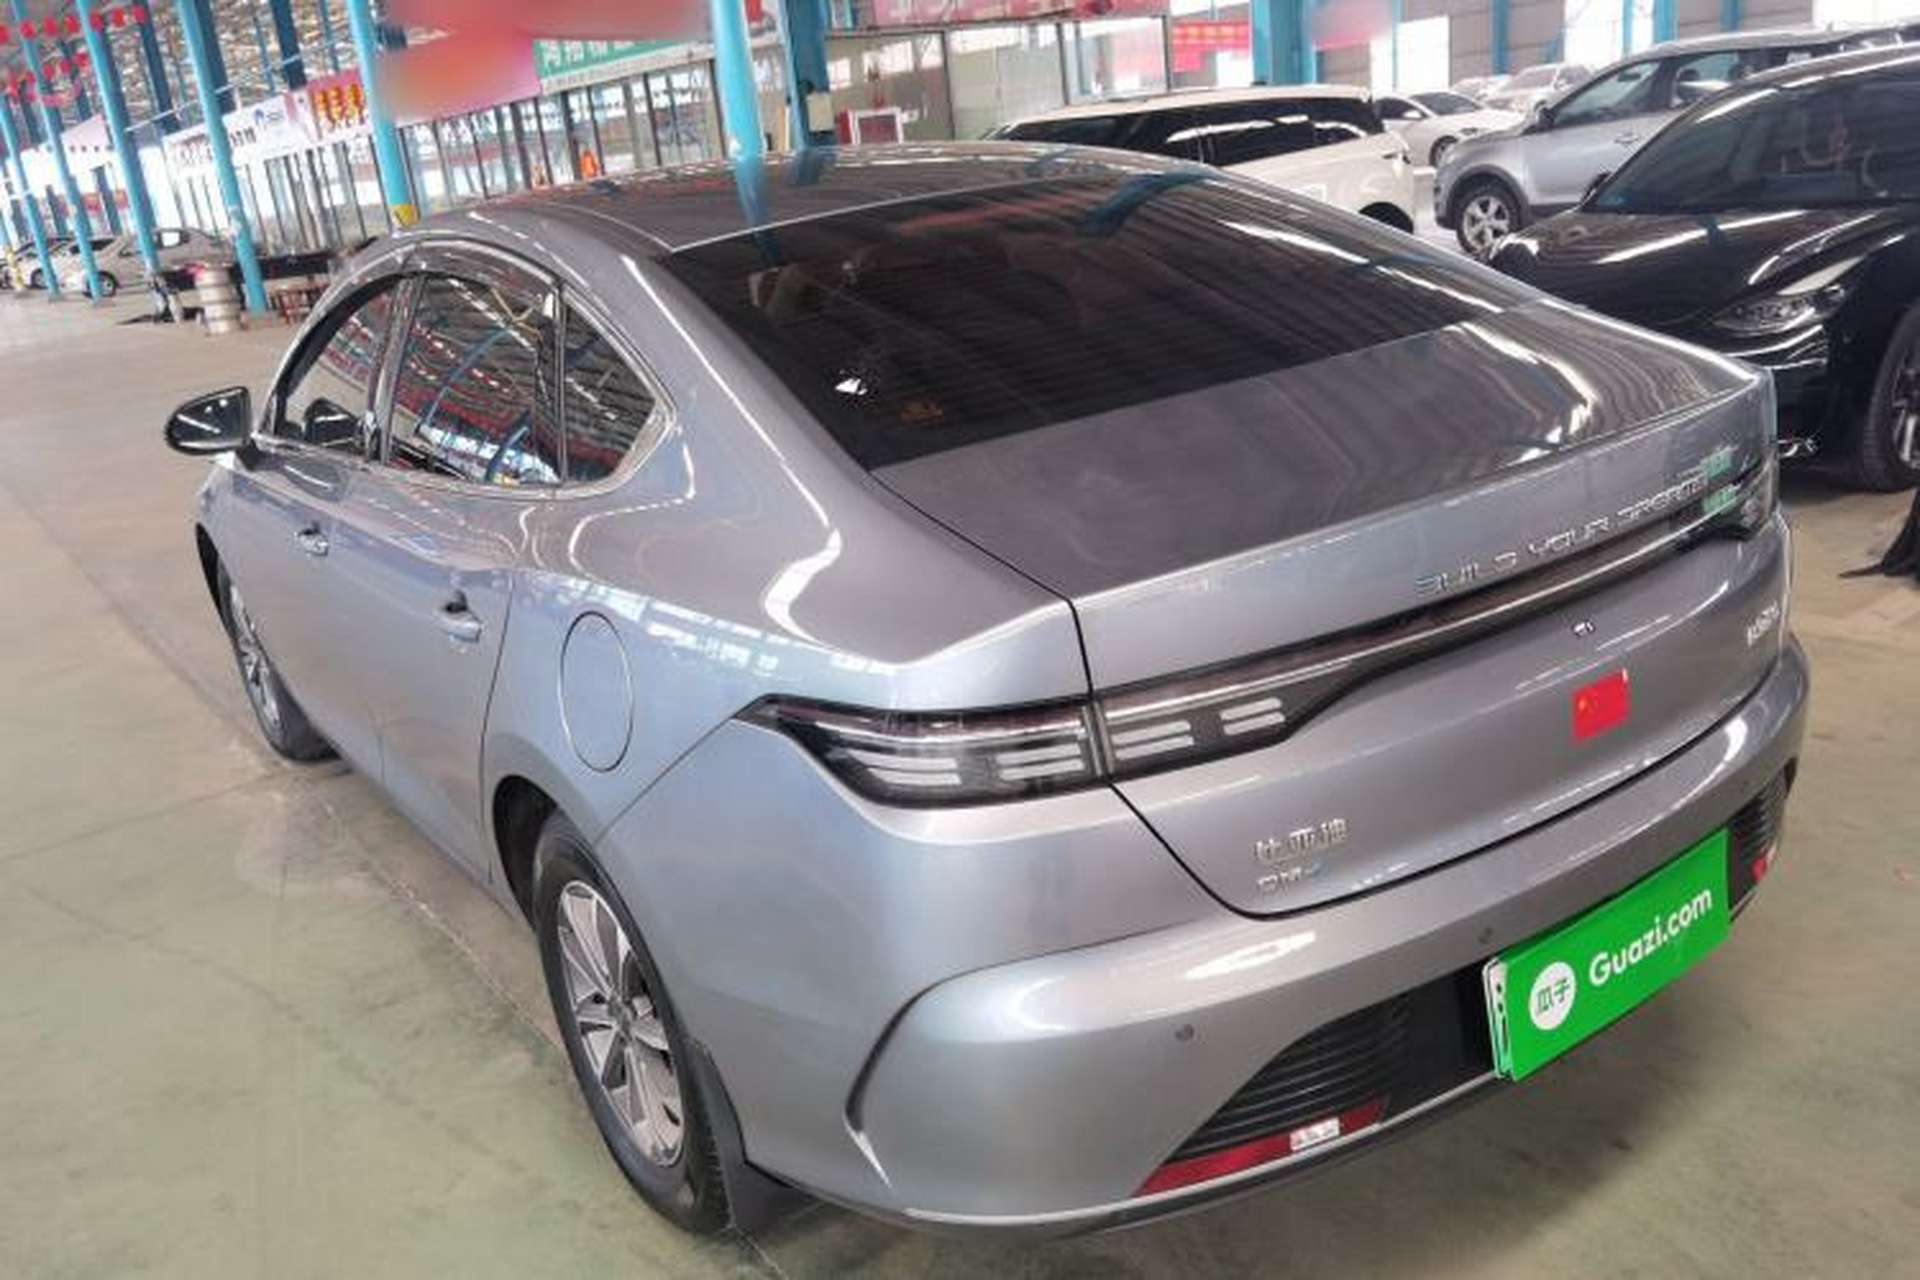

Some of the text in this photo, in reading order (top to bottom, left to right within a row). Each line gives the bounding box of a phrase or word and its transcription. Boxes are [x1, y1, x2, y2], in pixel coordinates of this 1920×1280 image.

[1414, 551, 1518, 595] BUILD
[1527, 516, 1610, 557] YOUR
[1588, 888, 1713, 987] Guazi.com
[1535, 976, 1571, 1016] 瓜子
